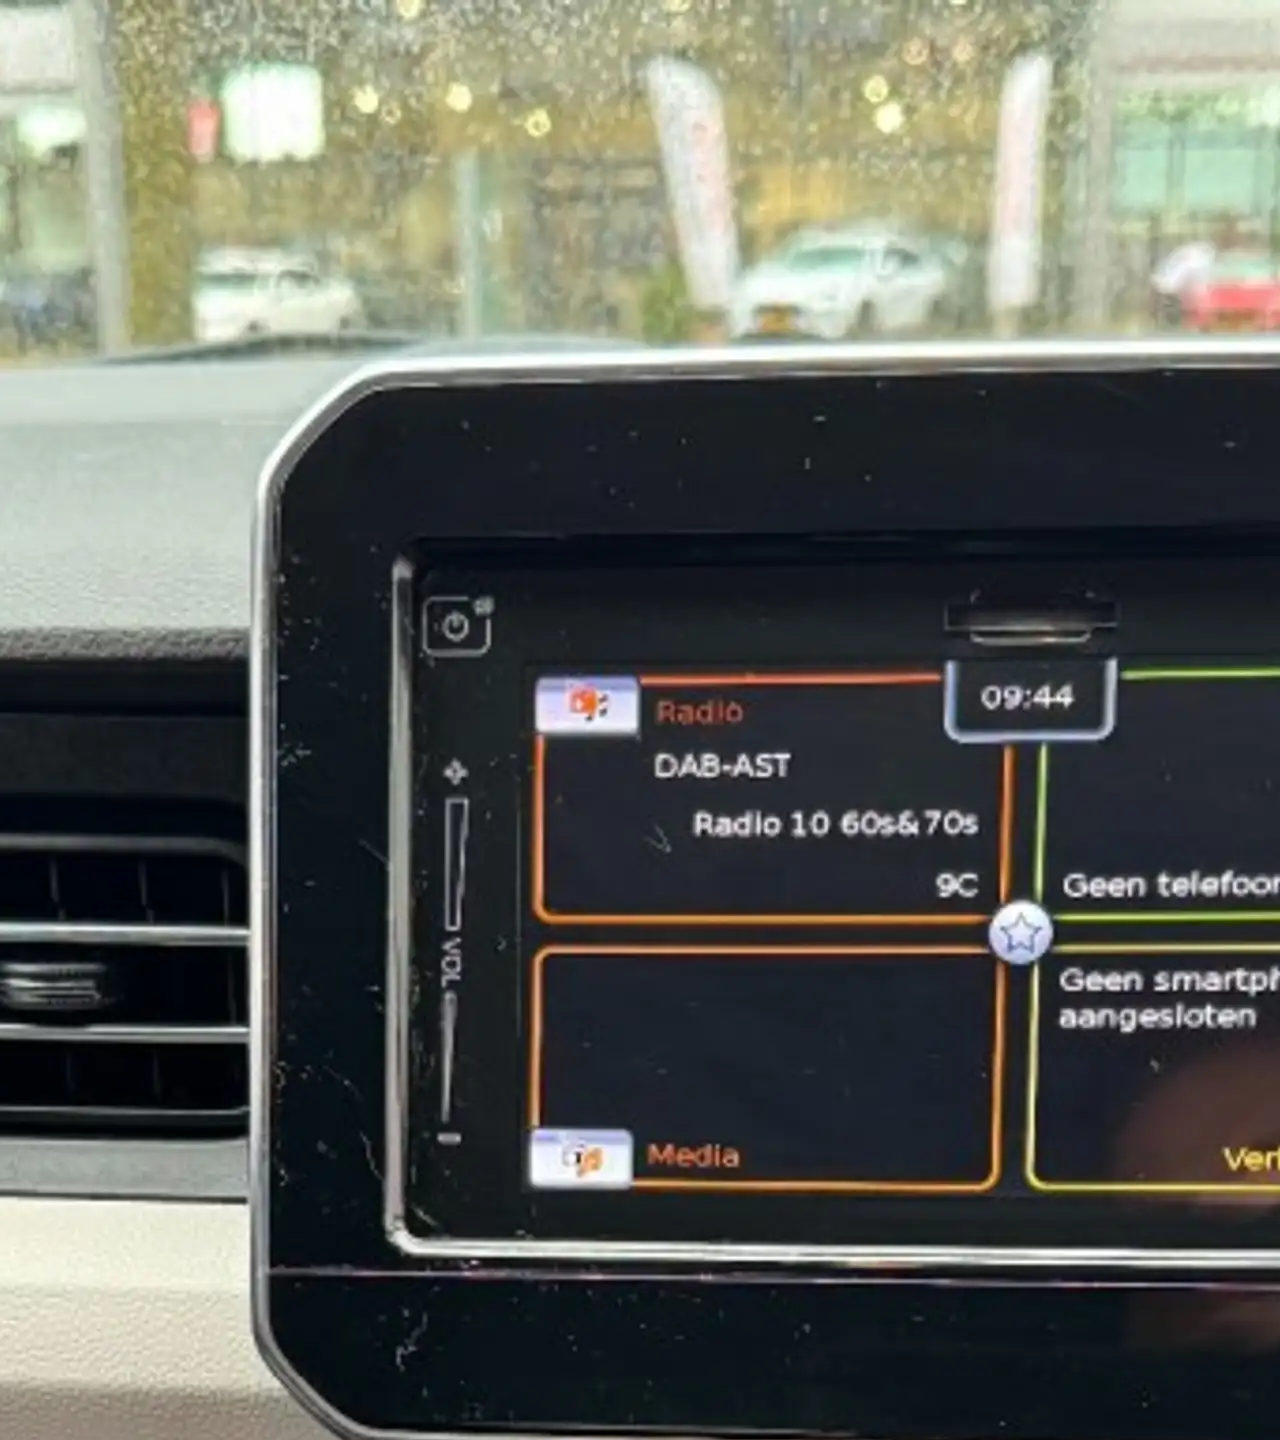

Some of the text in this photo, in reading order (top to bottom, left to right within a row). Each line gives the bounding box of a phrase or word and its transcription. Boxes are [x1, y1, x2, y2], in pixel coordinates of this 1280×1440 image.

[980, 684, 1074, 711] 09:44
[656, 700, 744, 725] Radio
[653, 753, 792, 779] DAB-AST
[692, 810, 782, 837] Radio
[791, 811, 829, 837] 10
[935, 873, 979, 899] 9C
[1062, 872, 1146, 898] Geen
[440, 937, 463, 987] VOL
[1059, 967, 1142, 993] Geen
[1059, 1004, 1257, 1034] aangesloten
[647, 1143, 740, 1168] Media
